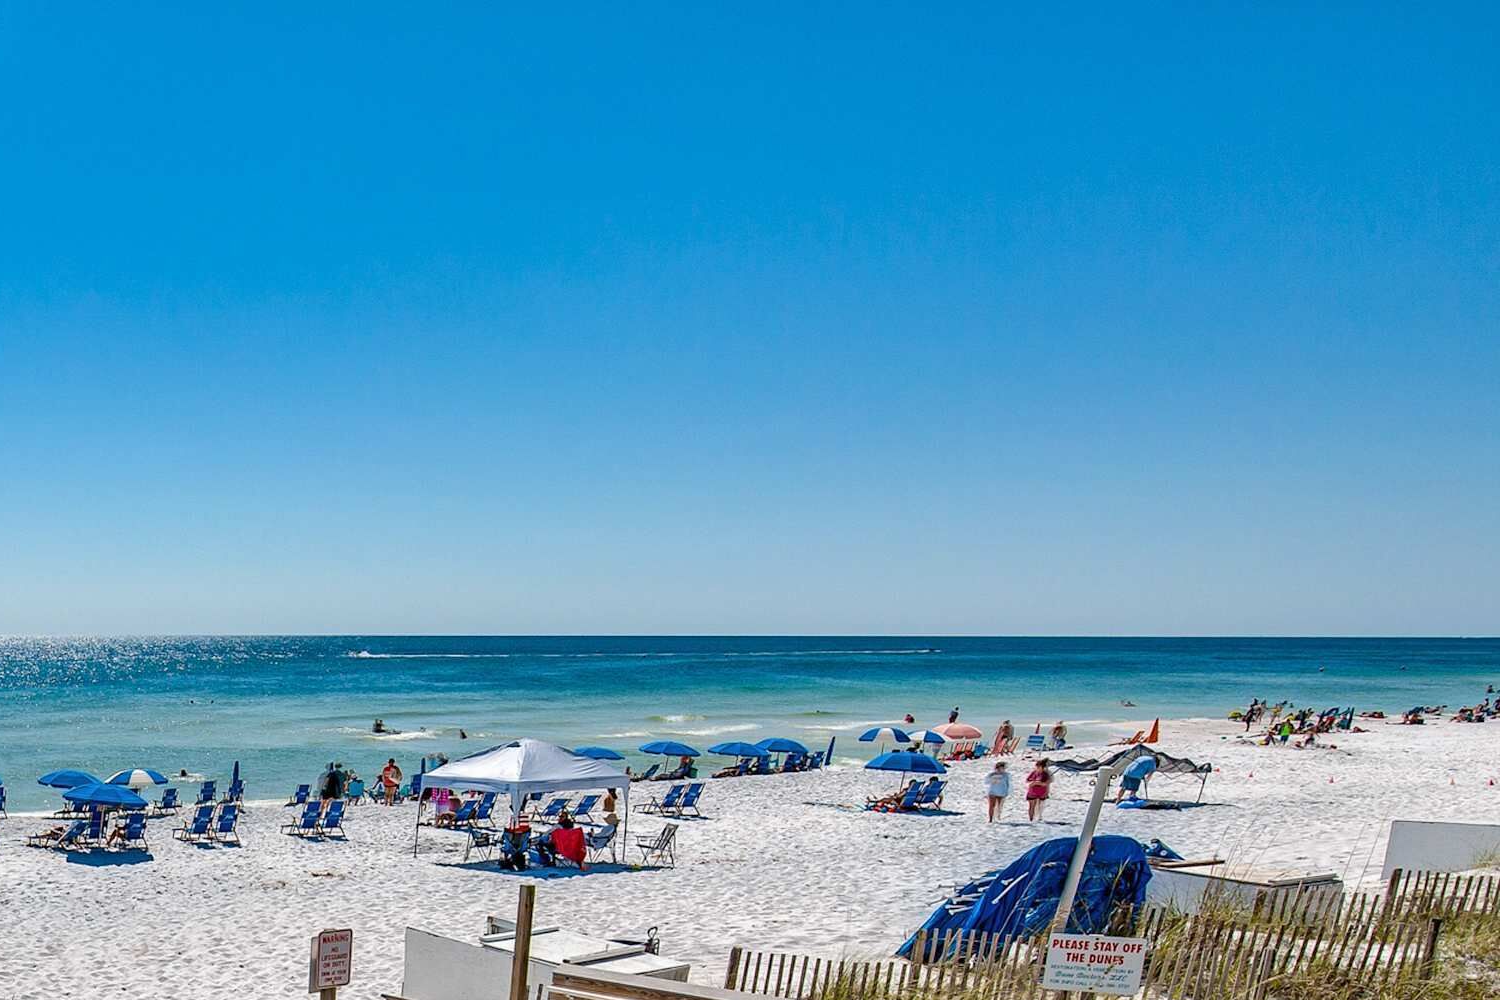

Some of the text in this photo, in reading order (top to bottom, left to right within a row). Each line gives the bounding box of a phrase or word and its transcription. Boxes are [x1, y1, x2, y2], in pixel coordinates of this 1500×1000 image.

[323, 933, 349, 944] WARNING
[1052, 939, 1143, 954] PLEASE STAY OFF
[322, 953, 348, 961] LIFEGUARD
[1066, 952, 1125, 965] THE DUNES
